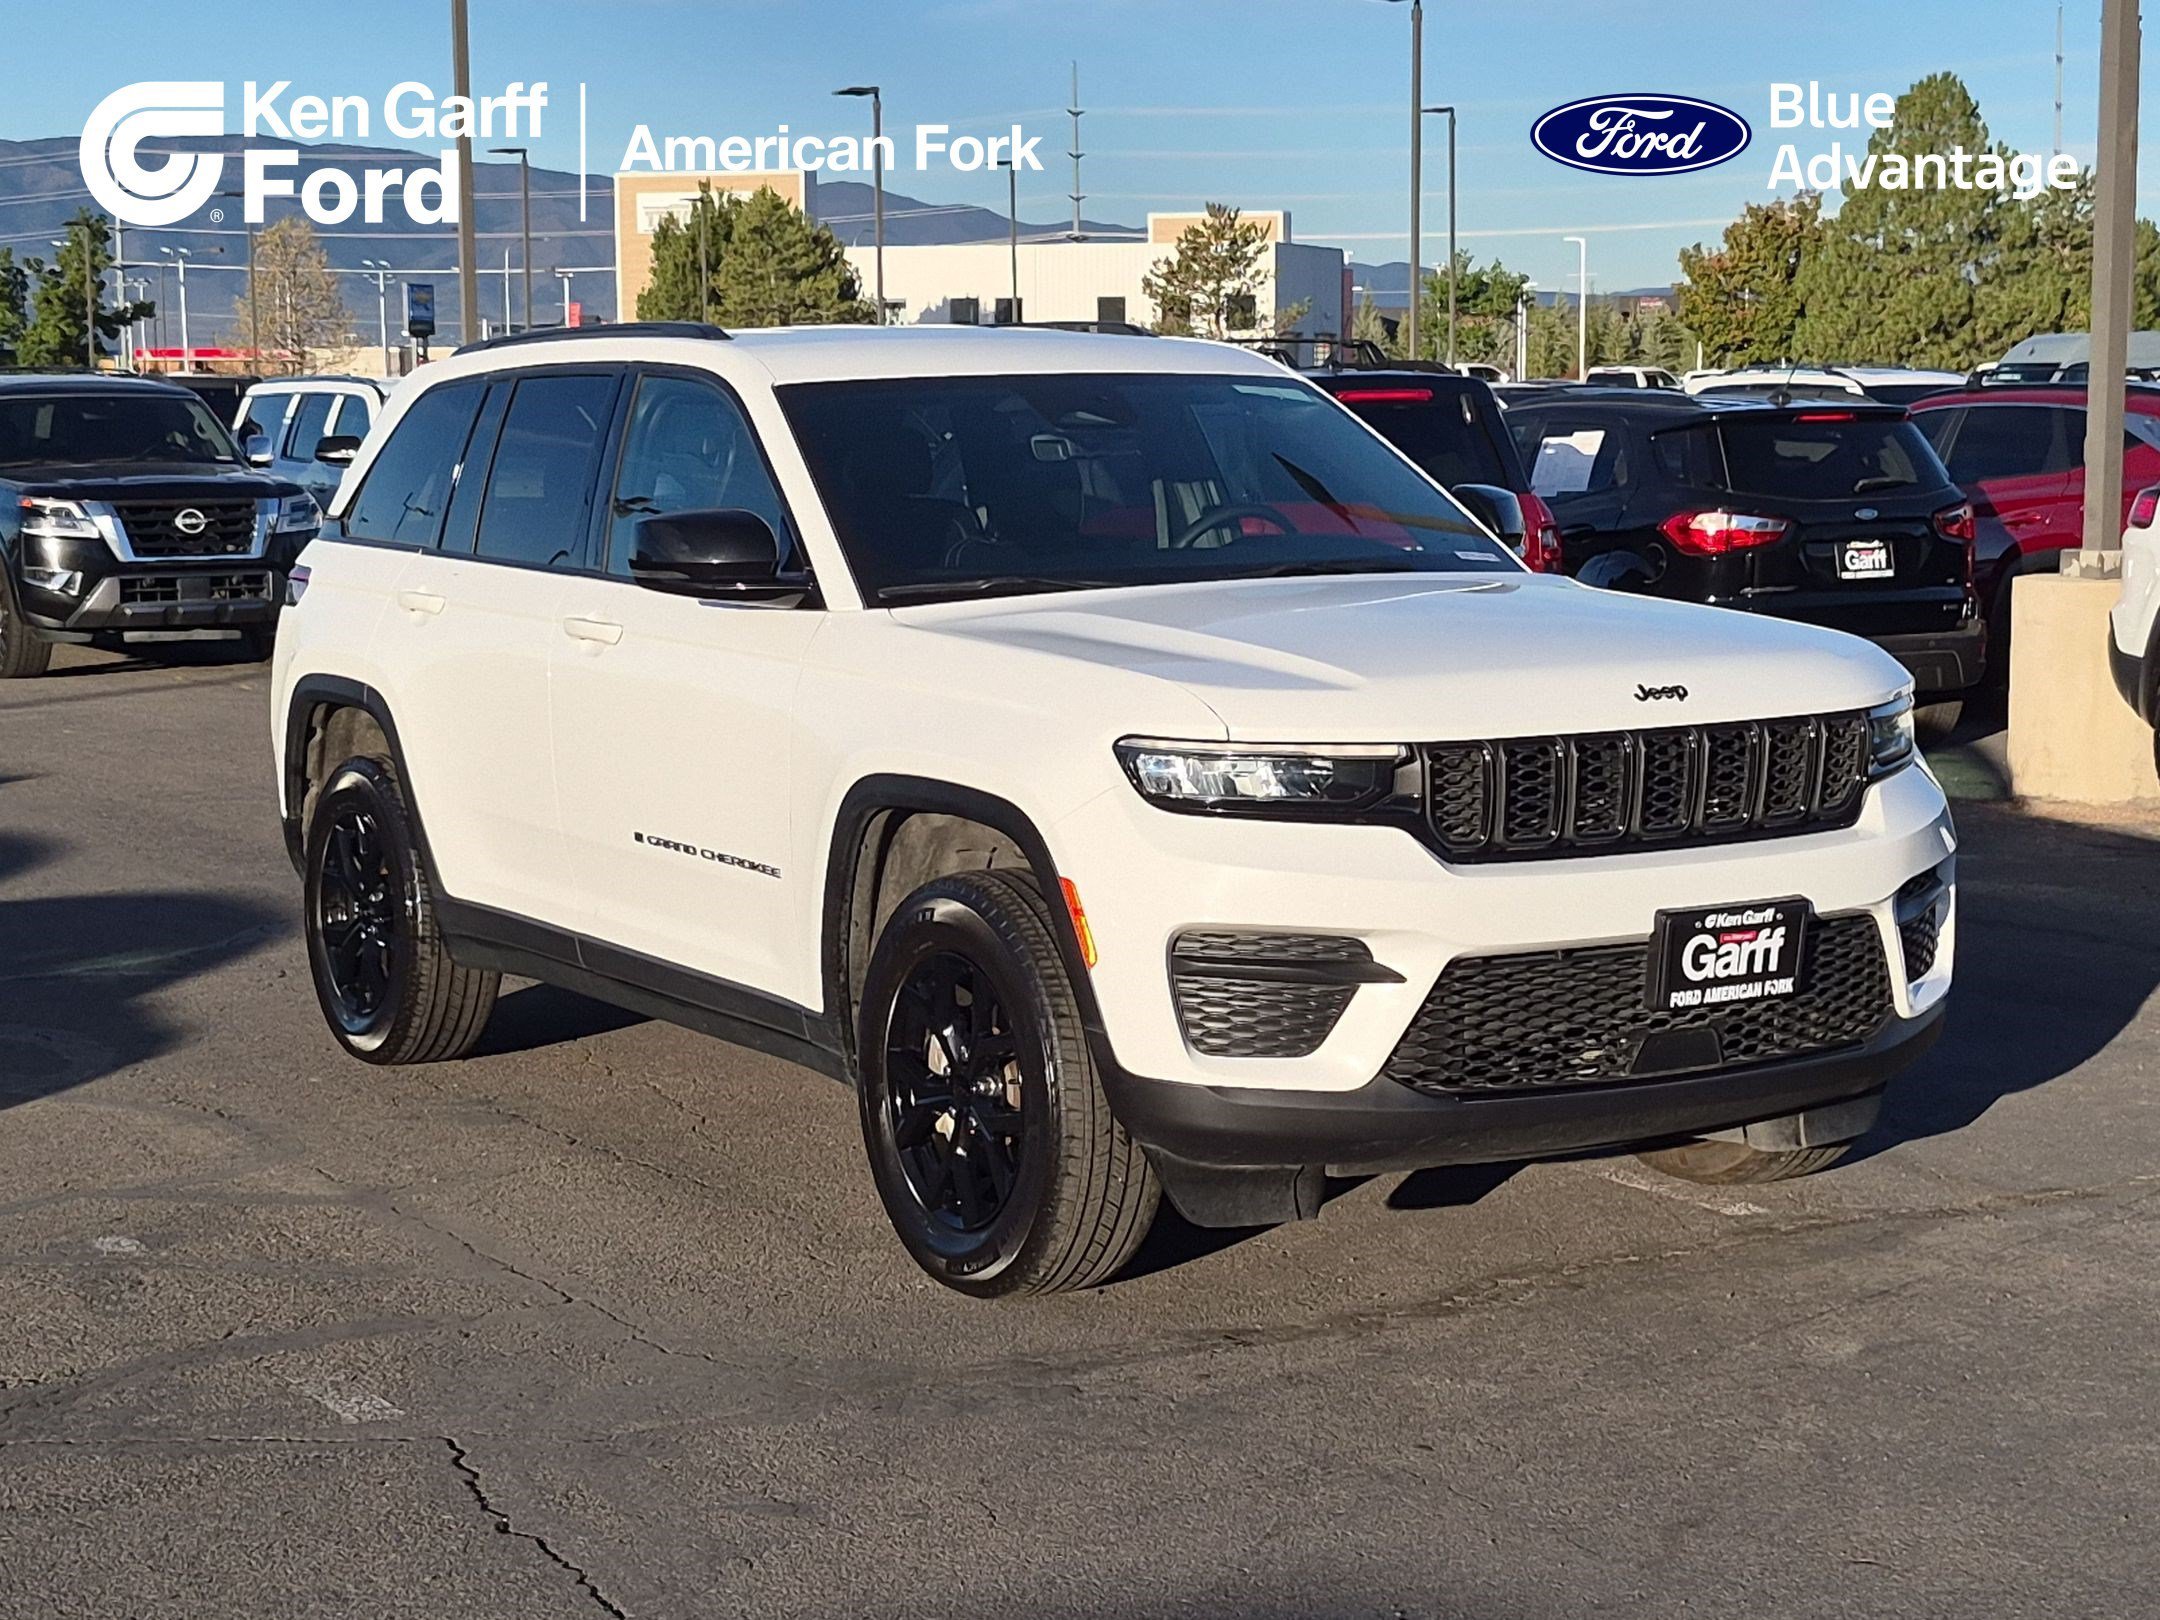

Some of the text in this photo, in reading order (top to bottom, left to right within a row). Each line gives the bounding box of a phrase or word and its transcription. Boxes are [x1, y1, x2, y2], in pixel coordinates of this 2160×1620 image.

[1634, 683, 1689, 702] Jeep
[647, 835, 781, 878] GRAND CHEROKEE
[1716, 908, 1775, 927] Ken Garff
[1682, 927, 1786, 981] Garff
[1670, 978, 1793, 1007] FORD AMERICAN FORK
